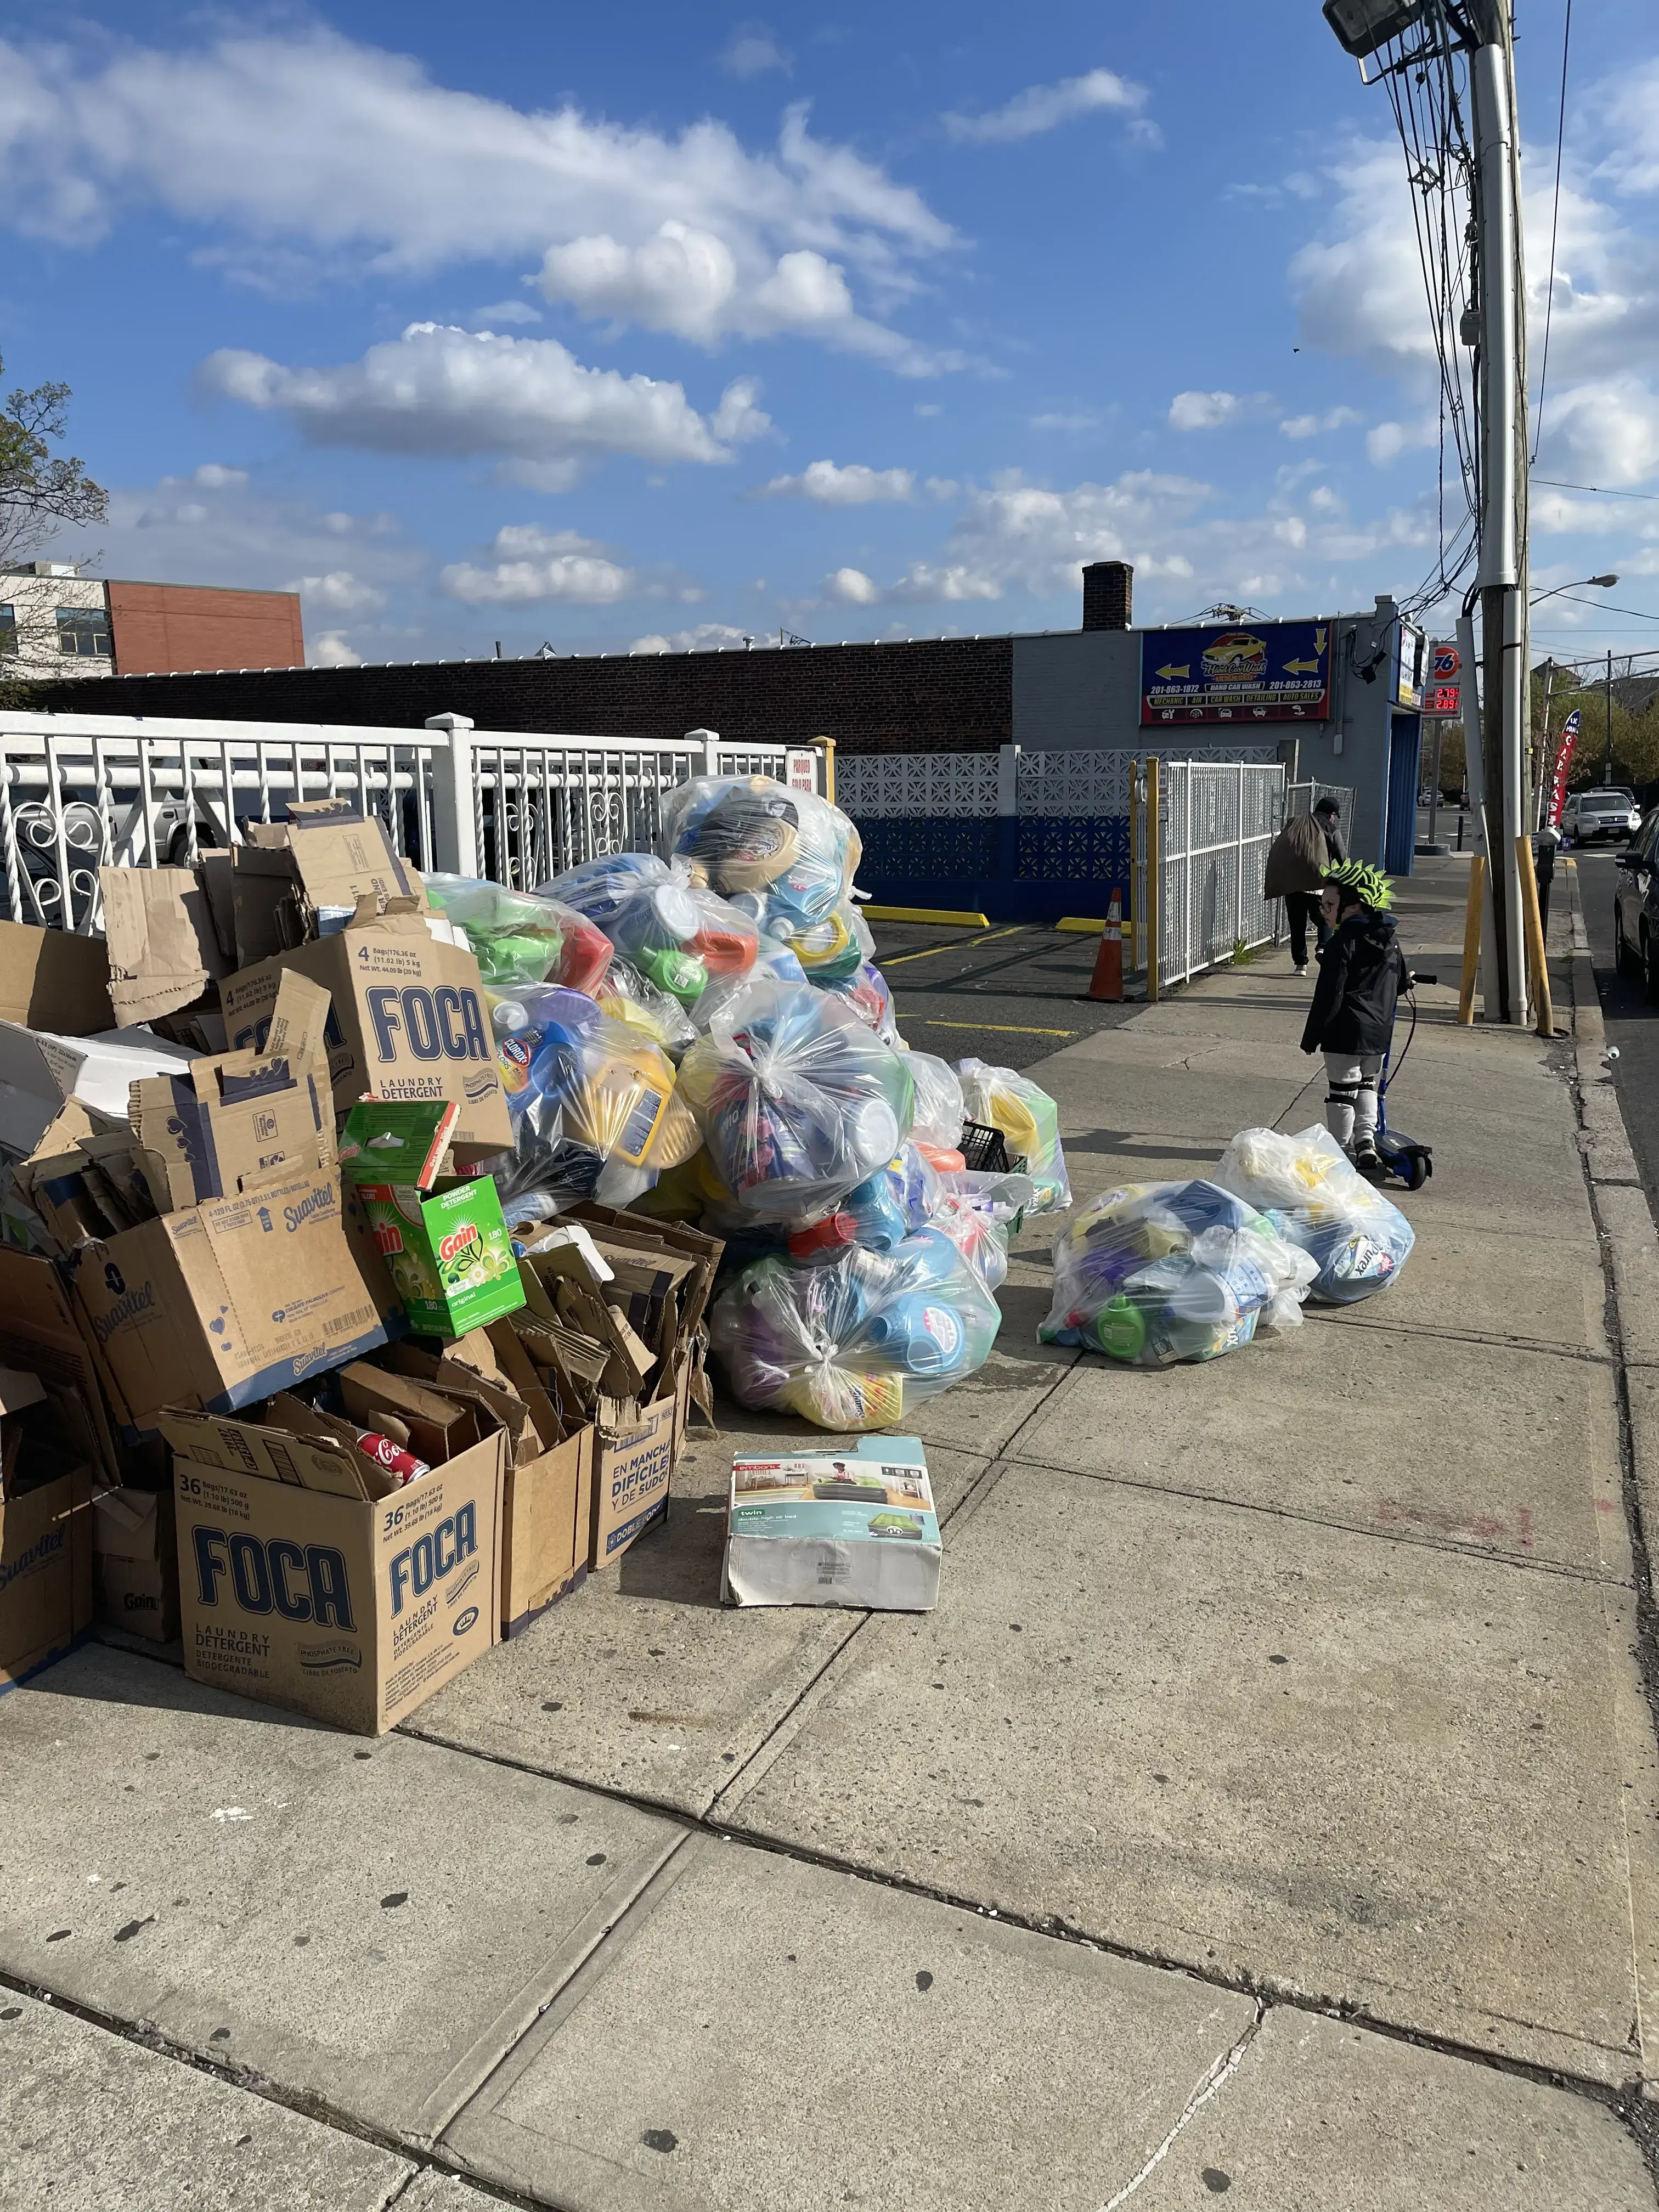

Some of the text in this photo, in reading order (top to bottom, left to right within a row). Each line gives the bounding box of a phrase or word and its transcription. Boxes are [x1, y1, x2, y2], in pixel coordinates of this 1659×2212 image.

[1206, 662, 1265, 674] Hand Car Wash
[1434, 654, 1455, 671] 76
[1150, 684, 1200, 694] 201-863-1872
[1269, 679, 1322, 690] 201-863-2813
[1153, 697, 1184, 706] MECHANIC
[1246, 693, 1277, 702] DETAILING
[1299, 692, 1319, 700] SALES
[793, 759, 810, 775] PARQUEO
[358, 946, 369, 962] 4
[226, 990, 234, 1006] 4
[365, 985, 491, 1063] FOCA
[380, 1077, 442, 1088] LAUNDRY
[382, 1086, 443, 1099] DETERGENT
[429, 1153, 438, 1167] Get
[435, 1139, 443, 1155] your
[441, 1189, 477, 1209] DETERGENT
[443, 1185, 470, 1201] POWDER
[440, 1224, 478, 1261] Gain
[488, 1228, 502, 1241] 180
[1354, 1242, 1380, 1276] Purex
[426, 1301, 437, 1310] 180
[452, 1291, 476, 1307] original
[613, 1462, 628, 1479] EN
[179, 1474, 201, 1495] 36
[202, 1481, 238, 1496] Bags/17.63
[180, 1494, 191, 1503] Net
[204, 1502, 220, 1511] 39.68
[229, 1508, 238, 1516] (18
[239, 1510, 250, 1521] kg)
[203, 1490, 219, 1502] (1.10
[221, 1496, 229, 1505] lb)
[230, 1498, 243, 1507] 500
[406, 1488, 435, 1510] Bags/17.63
[612, 1499, 619, 1512] Y
[622, 1488, 636, 1506] DE
[383, 1505, 404, 1532] 36
[405, 1509, 419, 1522] (1.10
[419, 1500, 427, 1511] lb)
[428, 1497, 439, 1506] 500
[383, 1534, 393, 1544] Net
[404, 1519, 418, 1531] 39.68
[419, 1513, 424, 1522] lb
[425, 1508, 433, 1519] (18
[434, 1503, 442, 1514] kg)
[389, 1499, 478, 1620] FOCA
[191, 1525, 358, 1633] FOCA
[124, 1592, 159, 1611] Gain
[393, 1594, 438, 1637] LAUNDRY
[393, 1600, 438, 1646] DETERGENT
[196, 1623, 270, 1645] LAUNDRY
[393, 1623, 427, 1655] DETERGENTE
[394, 1623, 434, 1662] BIODEGRADABLE
[195, 1633, 270, 1657] DETERGENT
[300, 1646, 356, 1657] PHOSPHATE-FREE
[196, 1649, 252, 1666] DETERGENTE
[196, 1659, 271, 1679] BIODEGRADABLE
